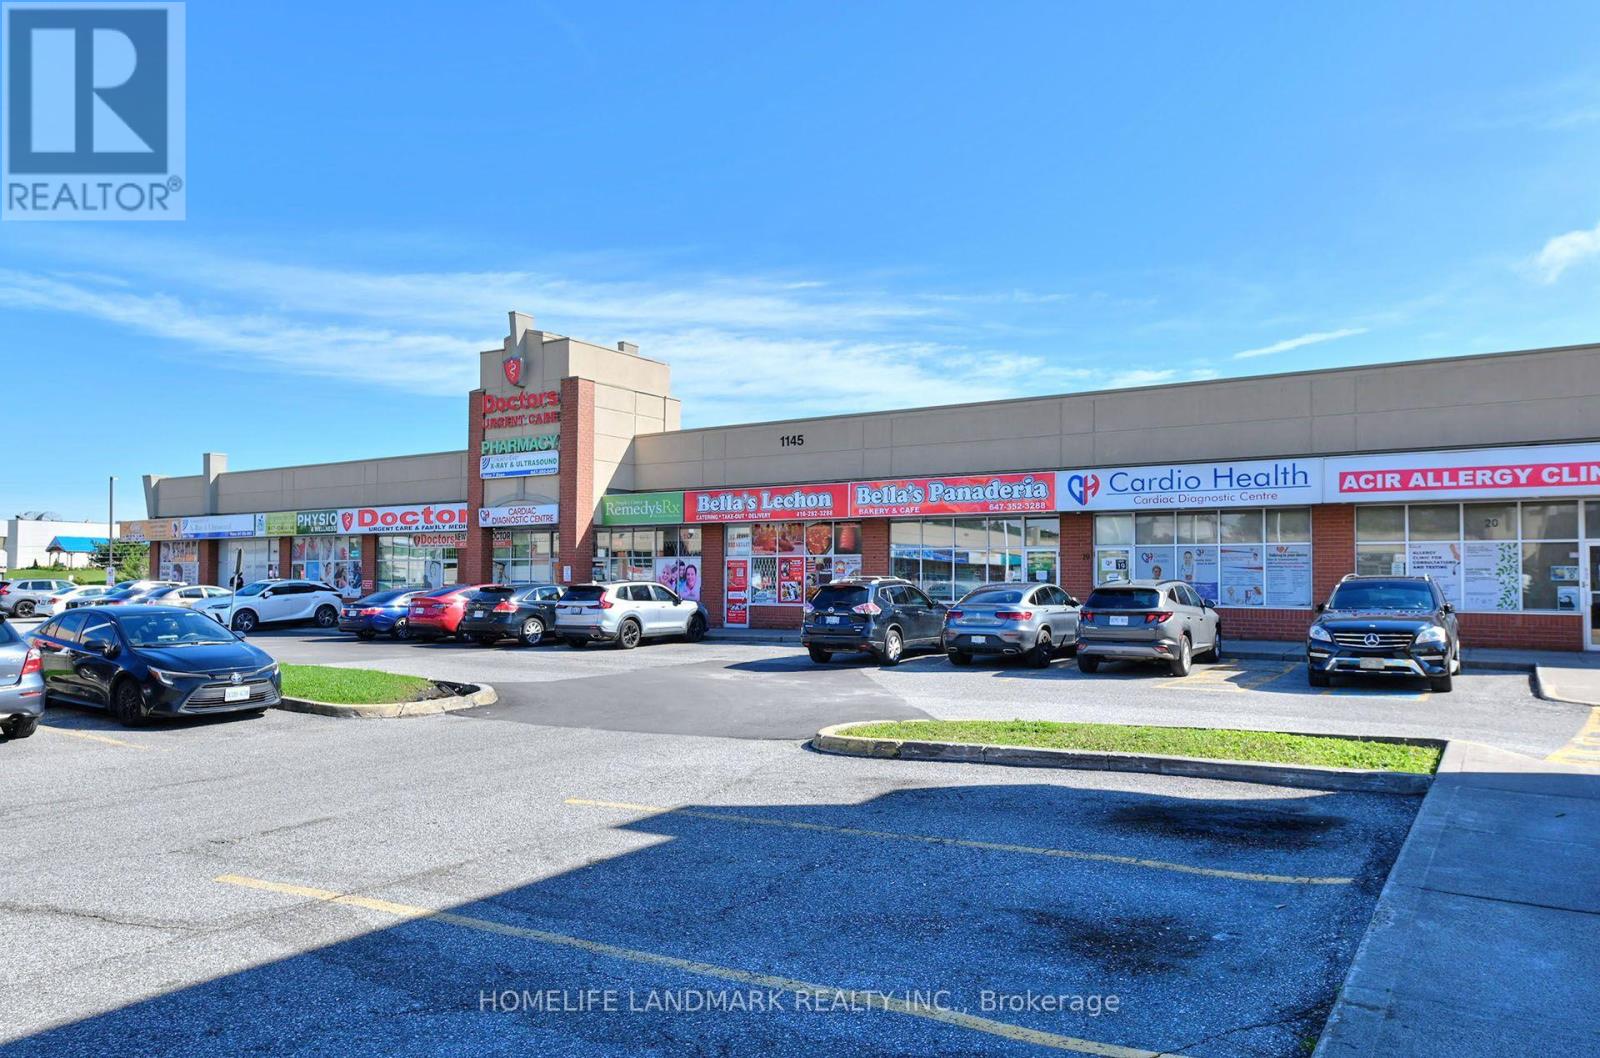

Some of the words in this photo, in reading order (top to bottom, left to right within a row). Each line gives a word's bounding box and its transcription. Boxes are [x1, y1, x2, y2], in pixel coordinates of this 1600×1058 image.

[482, 391, 559, 413] Doctors
[482, 415, 526, 429] URGENT
[528, 411, 559, 424] CARE
[481, 435, 558, 454] PHARMACY
[780, 434, 804, 447] 1145
[516, 458, 558, 467] ULTRASOUND
[1109, 469, 1201, 492] Cardio
[1213, 463, 1308, 488] Health
[1342, 474, 1401, 490] ACIR
[1408, 468, 1533, 488] ALLERGY
[856, 483, 924, 506] Bella's
[928, 477, 1048, 503] Panaderia
[1133, 495, 1174, 505] Cardiac
[1178, 493, 1235, 505] Diagnostic
[1239, 492, 1278, 501] Centre
[697, 493, 757, 512] Bella's
[760, 490, 833, 510] Lechon
[508, 507, 537, 516] CARDIAC
[297, 512, 337, 526] PHYSIO
[491, 515, 529, 525] DIAGNOSTIC
[529, 514, 554, 523] CENTRE
[1484, 518, 1499, 528] 20
[420, 534, 455, 545] Doctors
